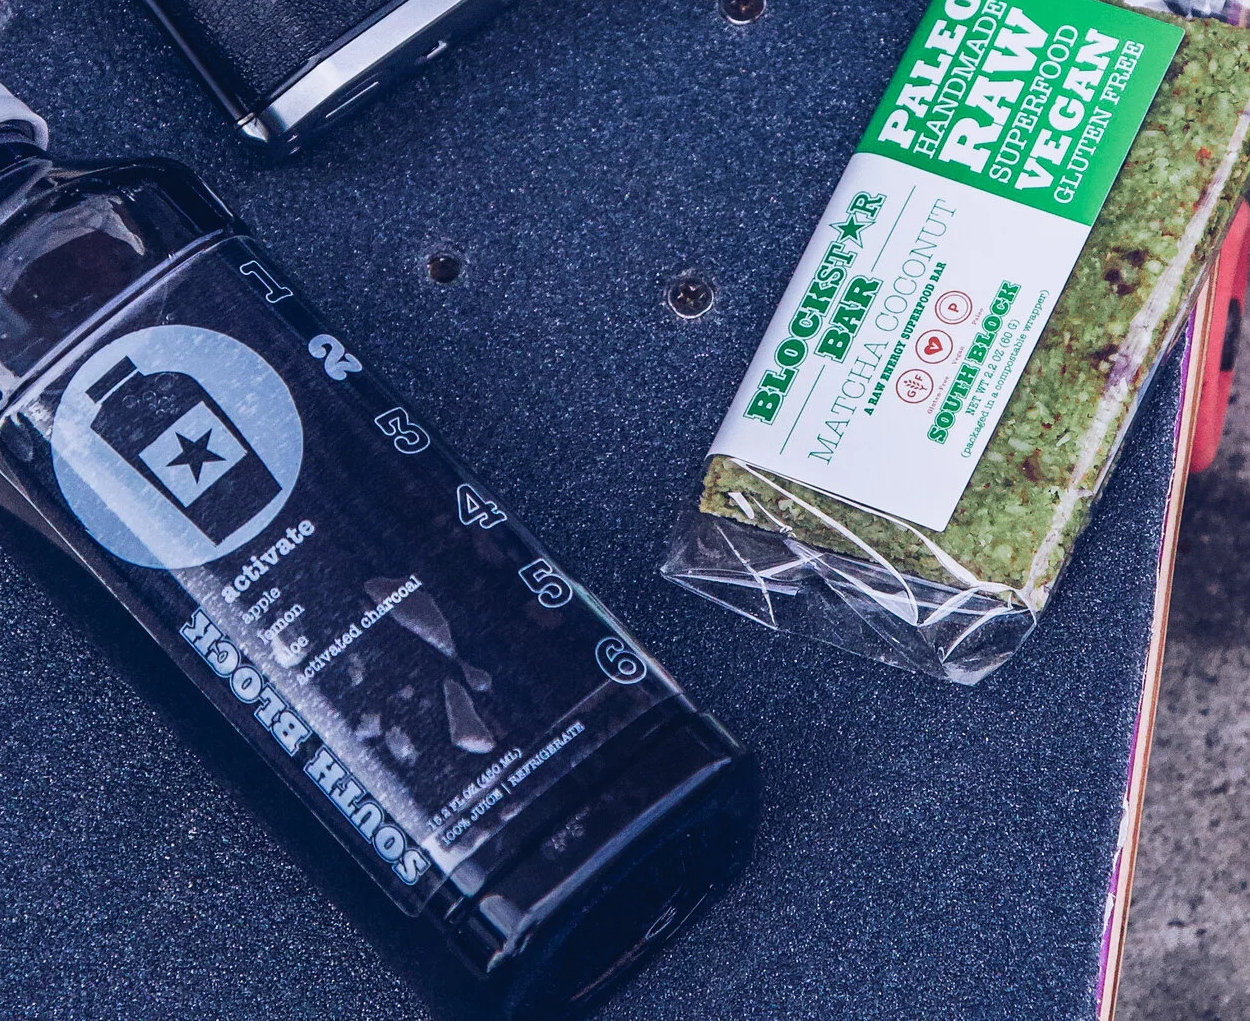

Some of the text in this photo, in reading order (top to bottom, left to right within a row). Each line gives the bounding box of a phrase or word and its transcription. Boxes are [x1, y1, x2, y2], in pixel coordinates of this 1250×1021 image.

[938, 6, 1049, 174] RAW
[988, 24, 1079, 184] SUPERFOOD
[1014, 28, 1120, 191] VEGAN
[1053, 40, 1145, 204] GLUTEN FREE
[239, 260, 294, 304] 1
[814, 274, 884, 363] BAR
[948, 302, 959, 313] P
[307, 333, 363, 381] 2
[808, 198, 957, 465] MATCHA COCONUT
[864, 261, 947, 416] A RAW ENERGY SUPERFOOD BAR
[927, 280, 1022, 445] SOUTH BLOCK
[960, 289, 1050, 458] (packaged in a compostable wrapper)
[965, 319, 1020, 416] NET WT 2.2 OZ (60 G)
[374, 407, 431, 454] 3
[456, 483, 508, 529] 4
[220, 518, 316, 604] activate
[241, 586, 281, 624] apple
[518, 558, 573, 608] 5
[257, 603, 305, 645] lemon
[273, 635, 309, 667] loe
[297, 574, 423, 685] activated charcoal
[595, 637, 647, 685] 6
[179, 608, 432, 886] SOUTH BLOCK
[441, 720, 586, 845] 100% JUICE REFRIGERATE
[499, 748, 523, 768] ML)
